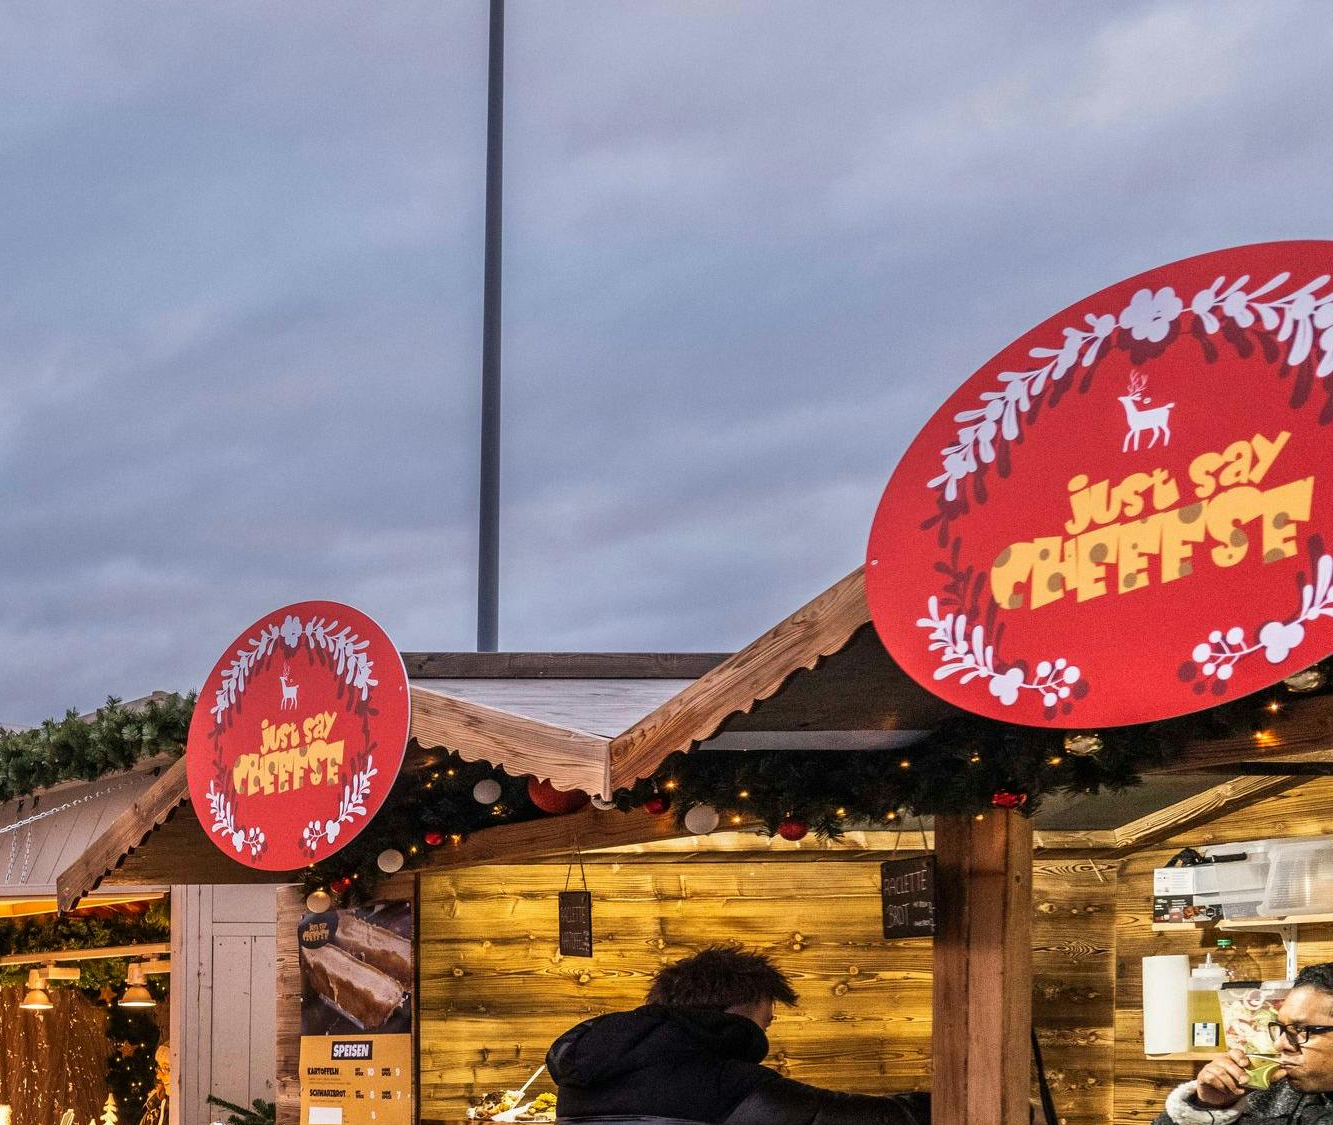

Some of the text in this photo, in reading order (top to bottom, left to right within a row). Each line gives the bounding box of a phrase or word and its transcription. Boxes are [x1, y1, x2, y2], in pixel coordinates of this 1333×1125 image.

[1065, 431, 1291, 535] just say
[260, 710, 337, 754] just say
[333, 1044, 369, 1057] SPEISEN
[307, 1067, 339, 1075] KARTOFFELN
